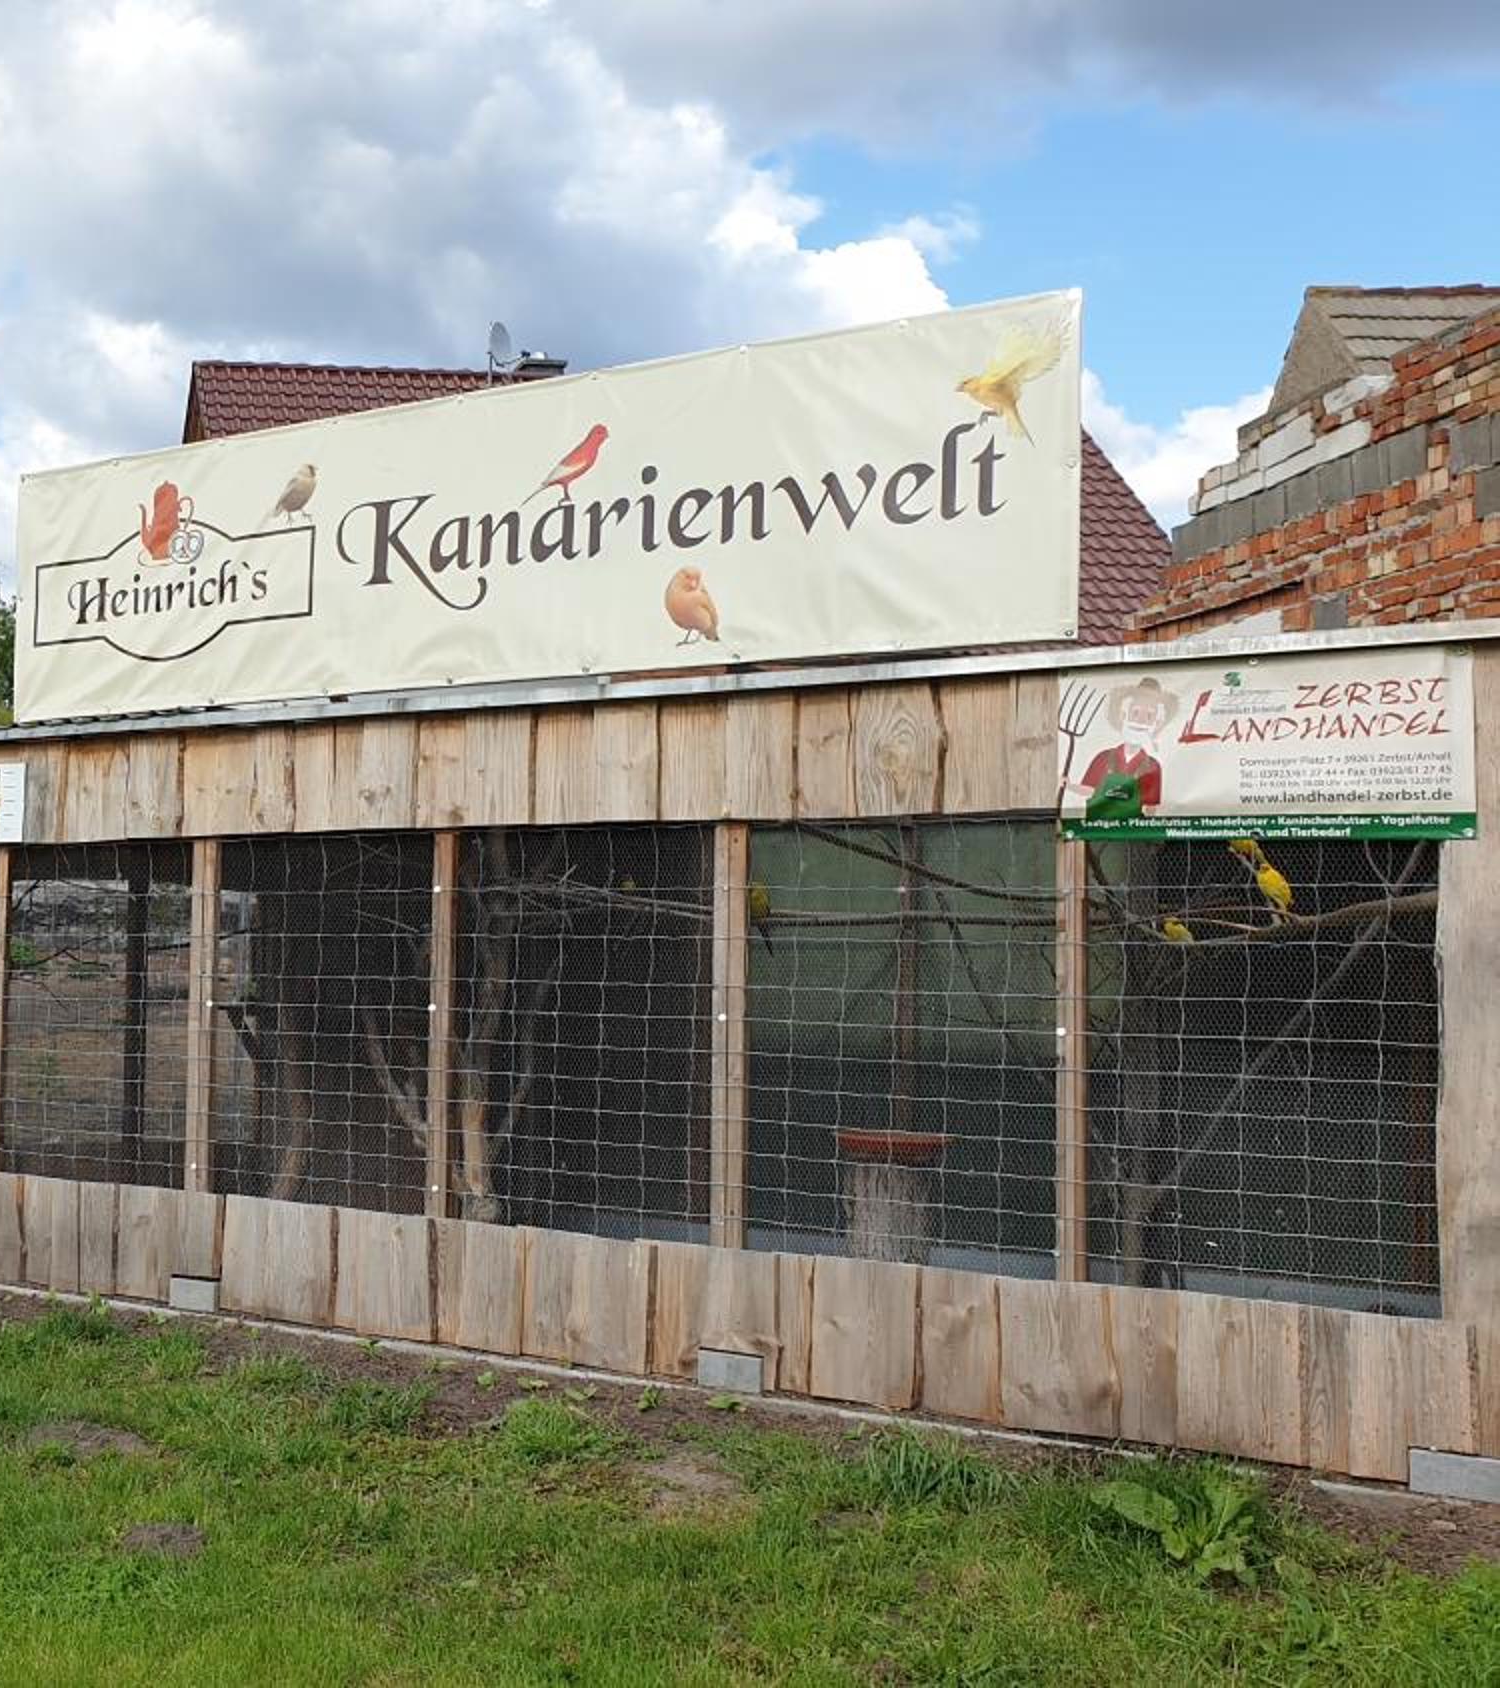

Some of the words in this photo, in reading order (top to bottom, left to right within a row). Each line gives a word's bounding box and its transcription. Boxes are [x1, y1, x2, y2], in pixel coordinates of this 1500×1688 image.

[335, 421, 1008, 611] Kanarienwelt
[1293, 677, 1451, 709] ZERBST
[1177, 689, 1452, 744] LANDHANDEL
[1239, 787, 1453, 804] www.landhandel-zerbst.de
[1200, 816, 1268, 827] Hundefutter
[1277, 815, 1372, 826] Kaninchenfutter
[1380, 814, 1451, 827] Vogelfutter
[1267, 827, 1288, 837] und
[1290, 826, 1351, 838] Tierbedarf
